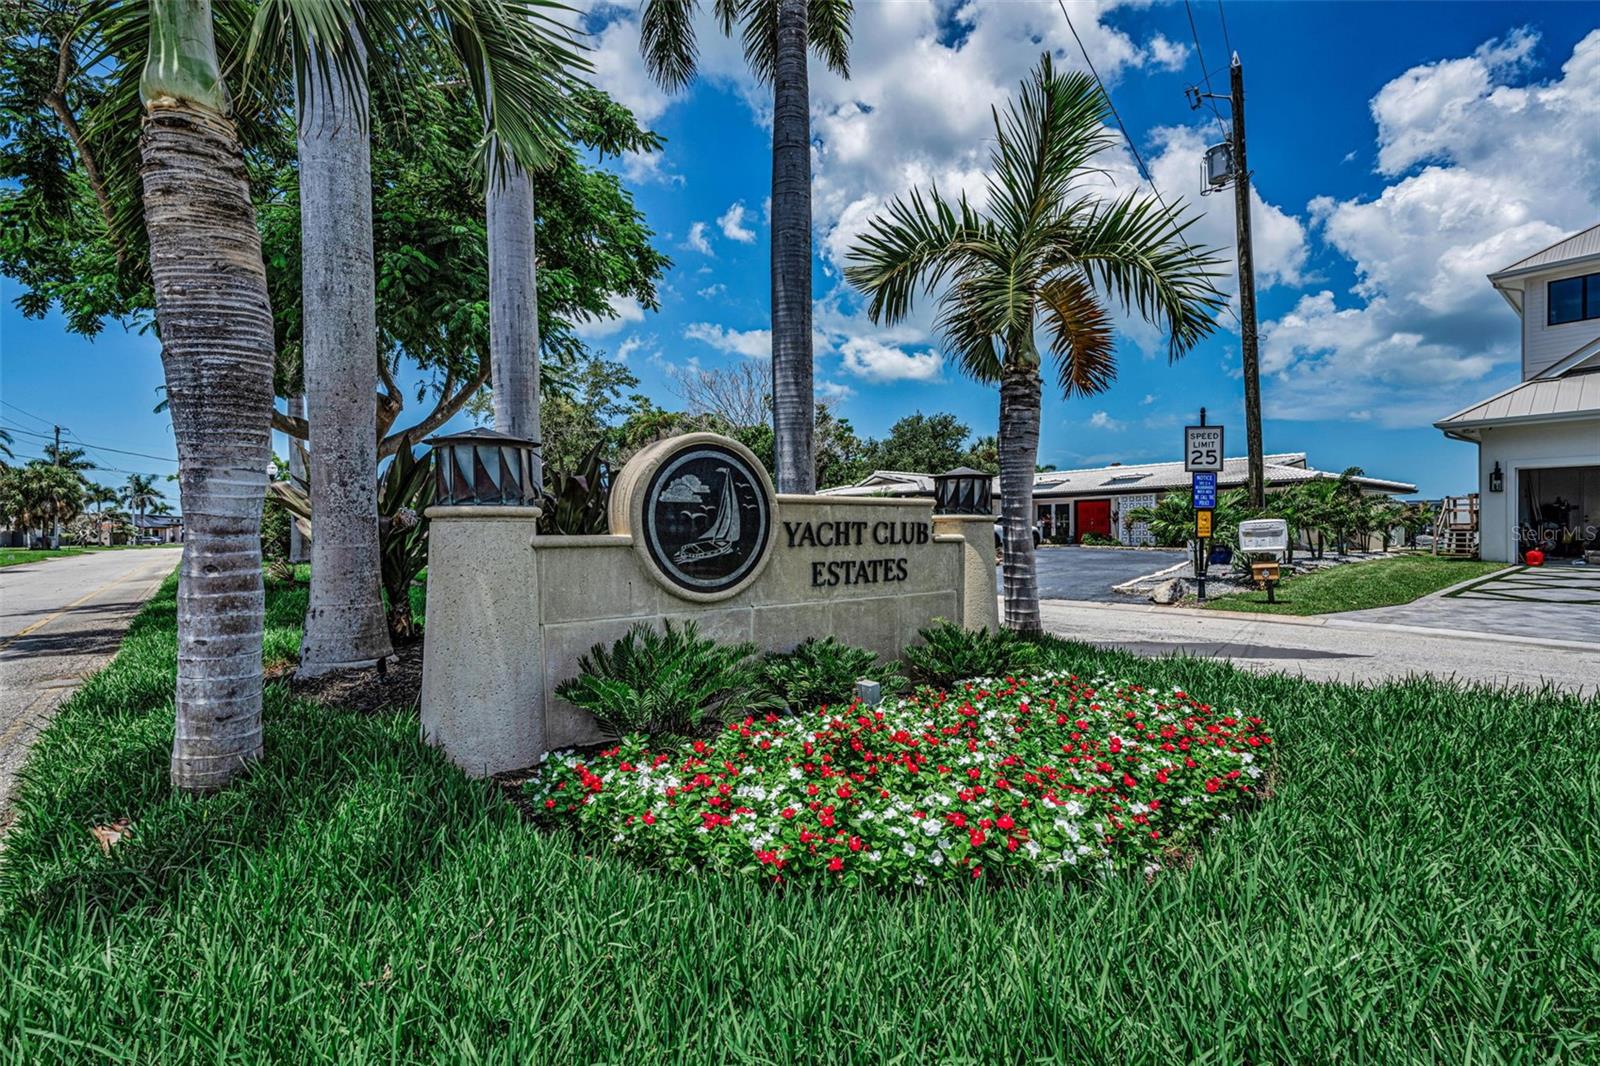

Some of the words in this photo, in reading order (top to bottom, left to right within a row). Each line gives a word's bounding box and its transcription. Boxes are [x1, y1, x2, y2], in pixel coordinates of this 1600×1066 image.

[1190, 432, 1219, 440] SPEED
[1193, 440, 1215, 448] LIMIT
[1191, 450, 1218, 465] 25
[783, 521, 868, 548] YACHT
[872, 521, 929, 546] CLUB
[811, 558, 908, 587] ESTATES
